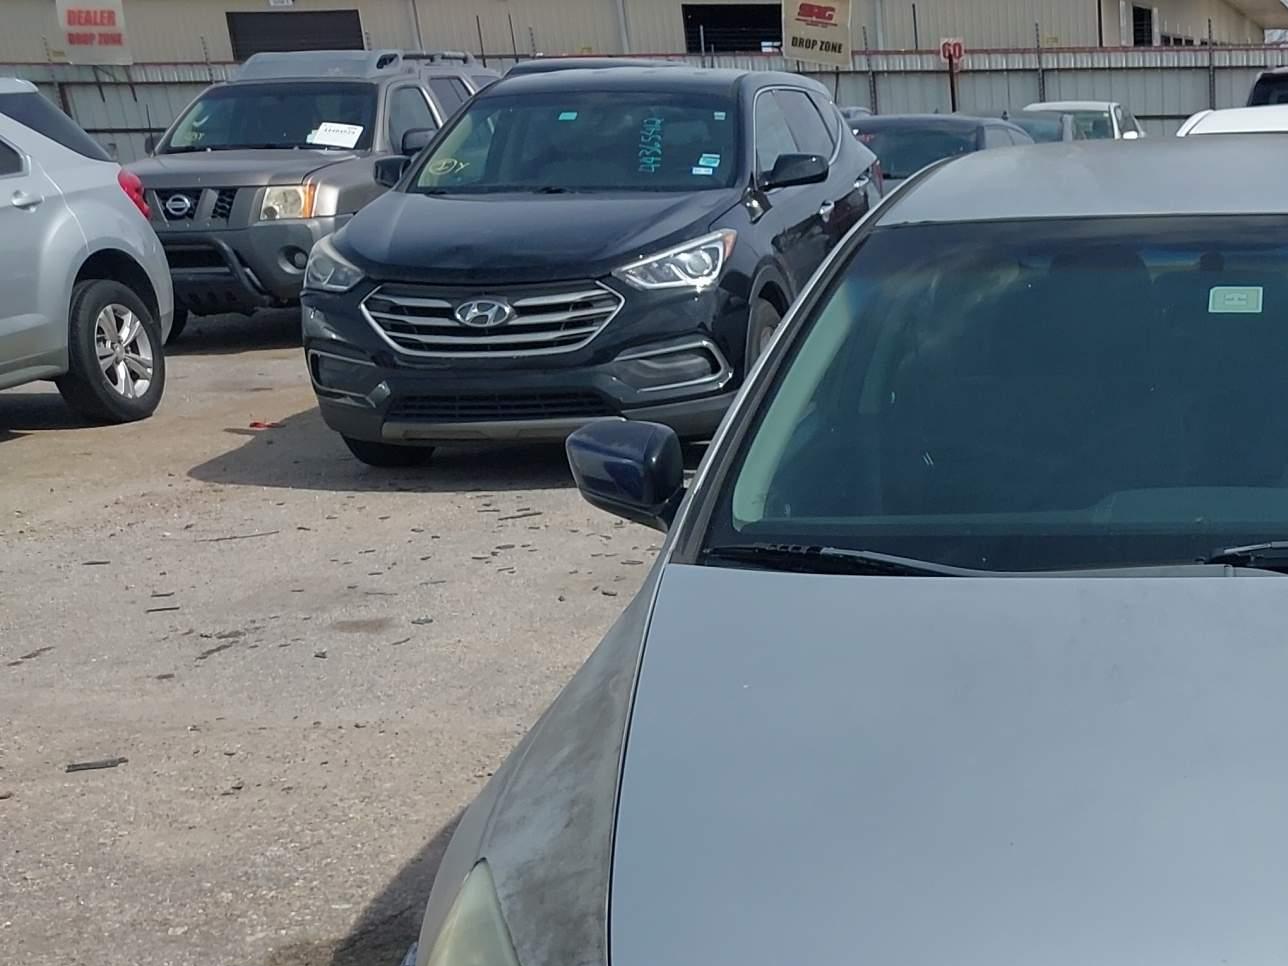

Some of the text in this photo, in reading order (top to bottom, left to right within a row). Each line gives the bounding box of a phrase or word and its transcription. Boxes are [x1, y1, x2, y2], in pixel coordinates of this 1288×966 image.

[67, 9, 116, 26] DEALER
[67, 32, 95, 46] DROP
[791, 36, 843, 54] DROP ZONE
